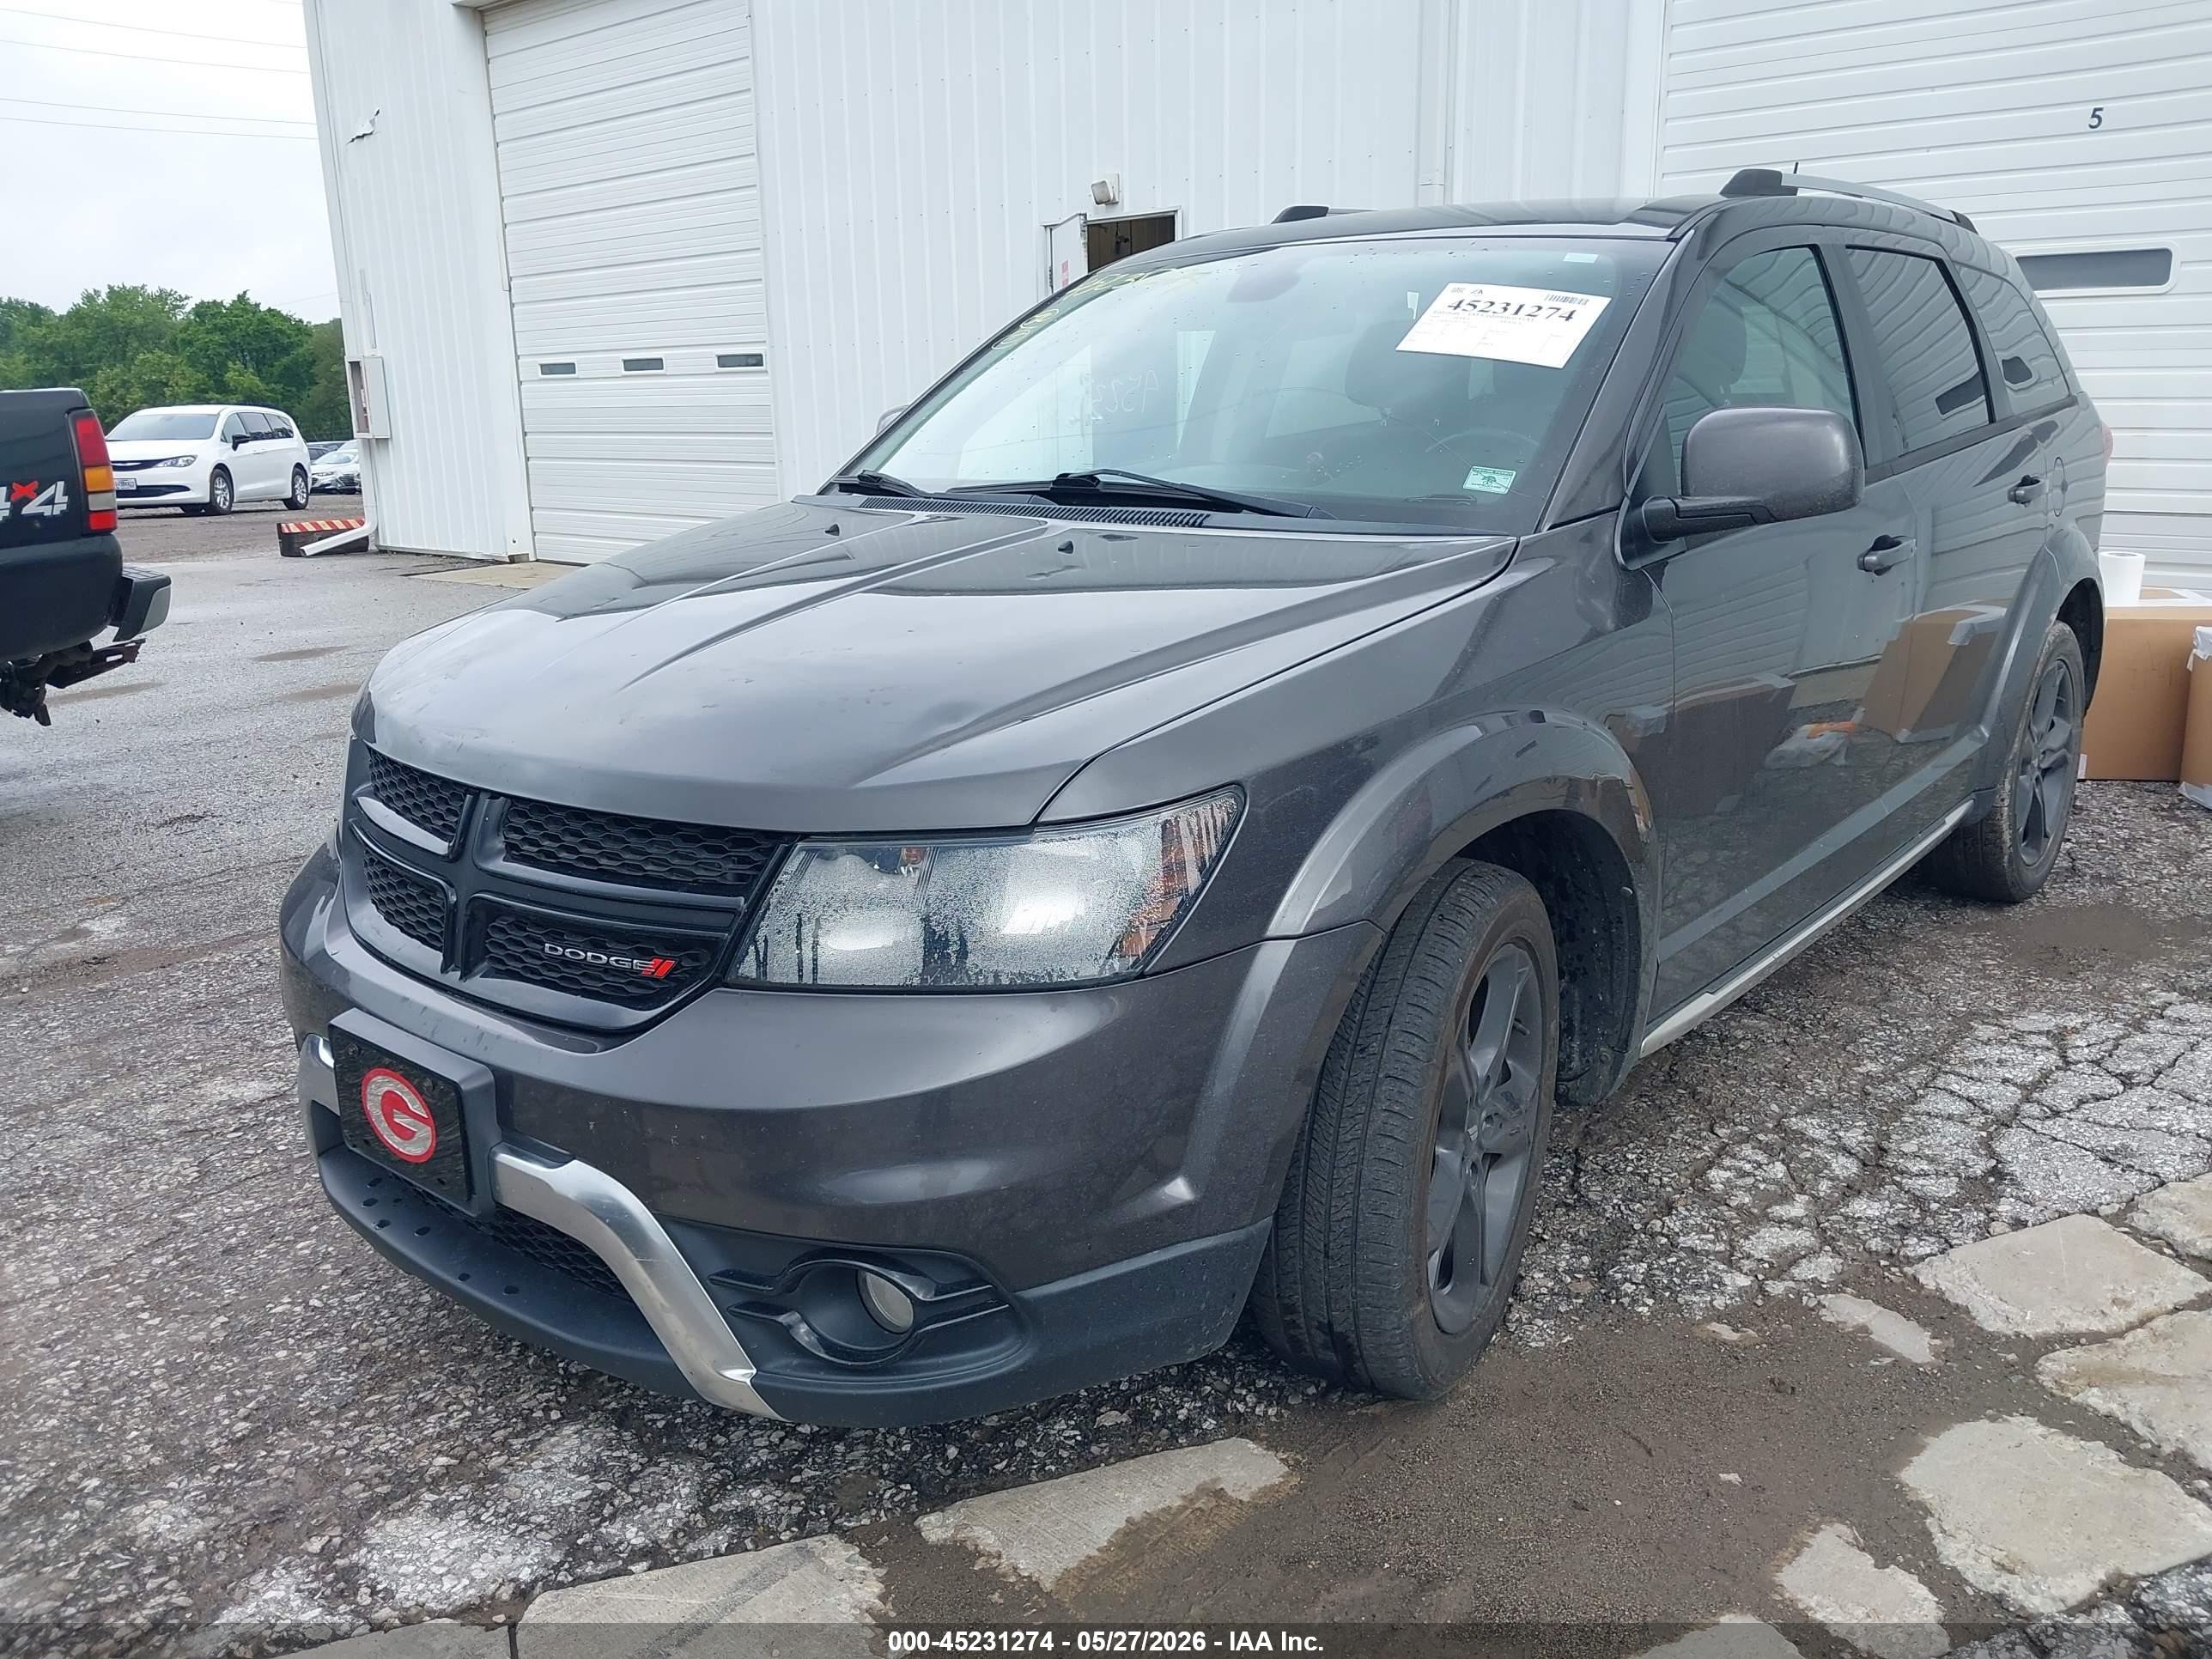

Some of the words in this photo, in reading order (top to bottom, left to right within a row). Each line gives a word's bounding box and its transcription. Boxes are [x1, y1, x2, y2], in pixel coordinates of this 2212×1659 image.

[2088, 107, 2104, 129] 5
[1447, 298, 1577, 322] 45231274
[544, 943, 655, 972] DODGE
[365, 1073, 434, 1158] G
